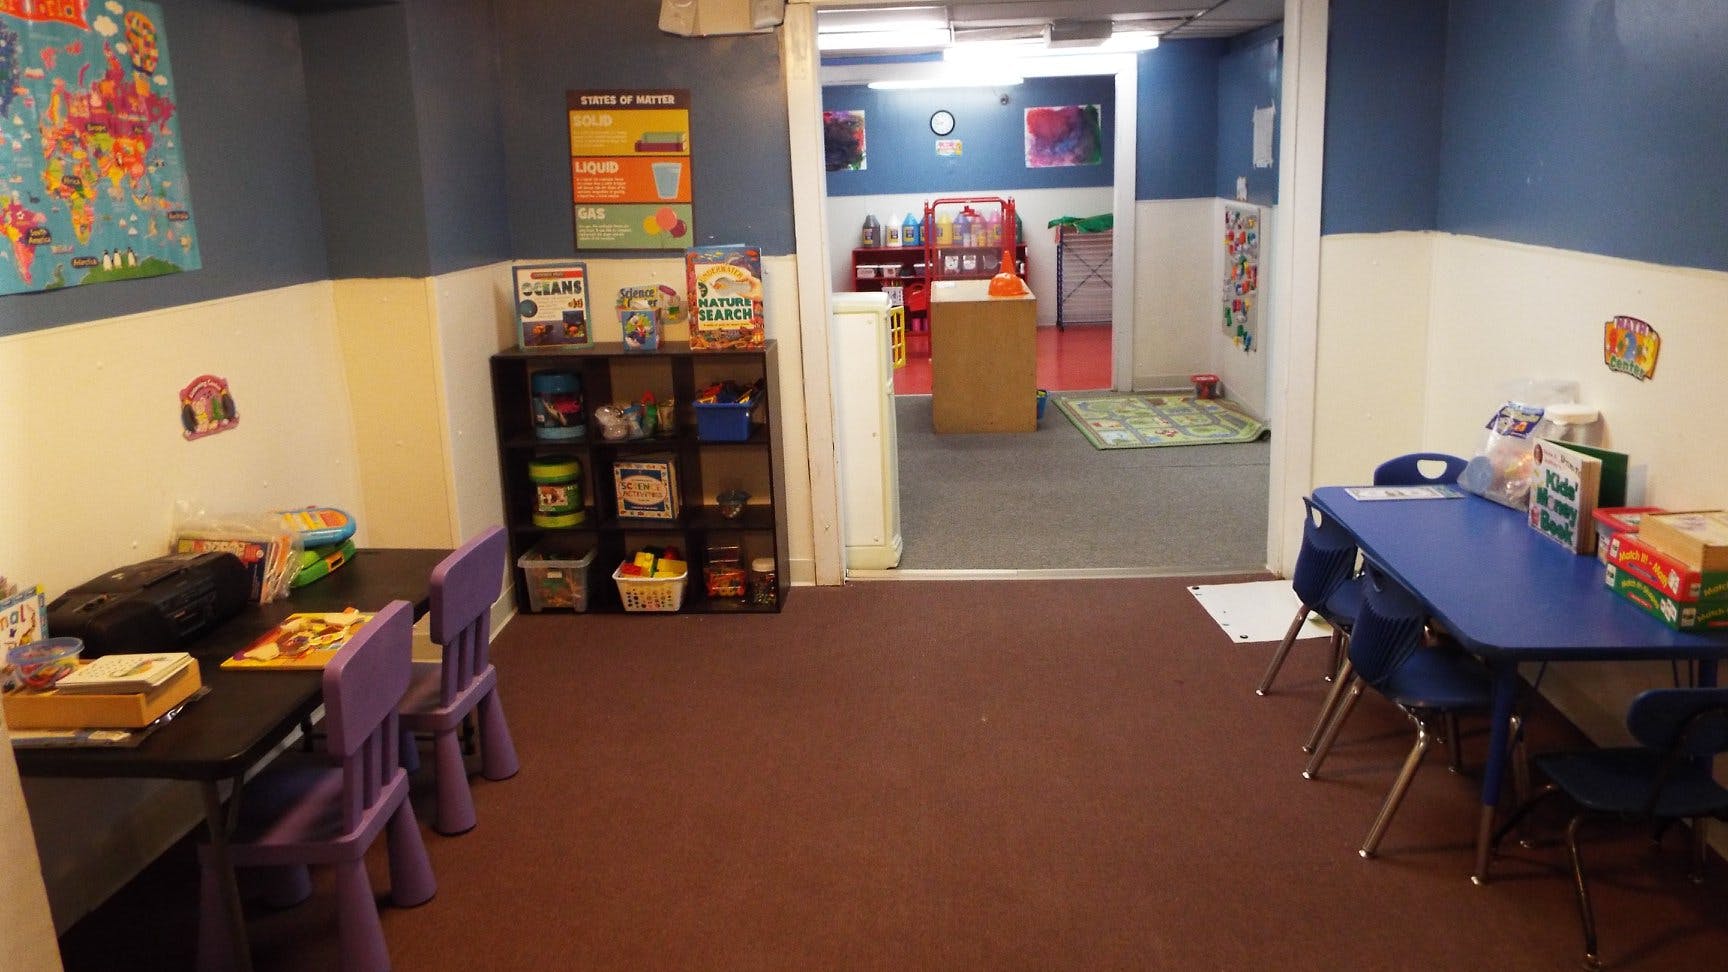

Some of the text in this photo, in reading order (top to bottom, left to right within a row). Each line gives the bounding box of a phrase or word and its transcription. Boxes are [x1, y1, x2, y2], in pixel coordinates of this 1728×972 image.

[580, 94, 675, 105] STATES OF MATTER
[573, 114, 613, 127] SOLID
[575, 161, 619, 175] LIQUID
[577, 207, 606, 220] GAS
[522, 280, 582, 296] OCEANS
[620, 287, 655, 299] Science
[698, 297, 752, 308] NATURE
[699, 308, 753, 321] SEARCH
[1546, 468, 1578, 501] Kids'
[1536, 487, 1577, 527] Money
[1541, 508, 1573, 546] Book
